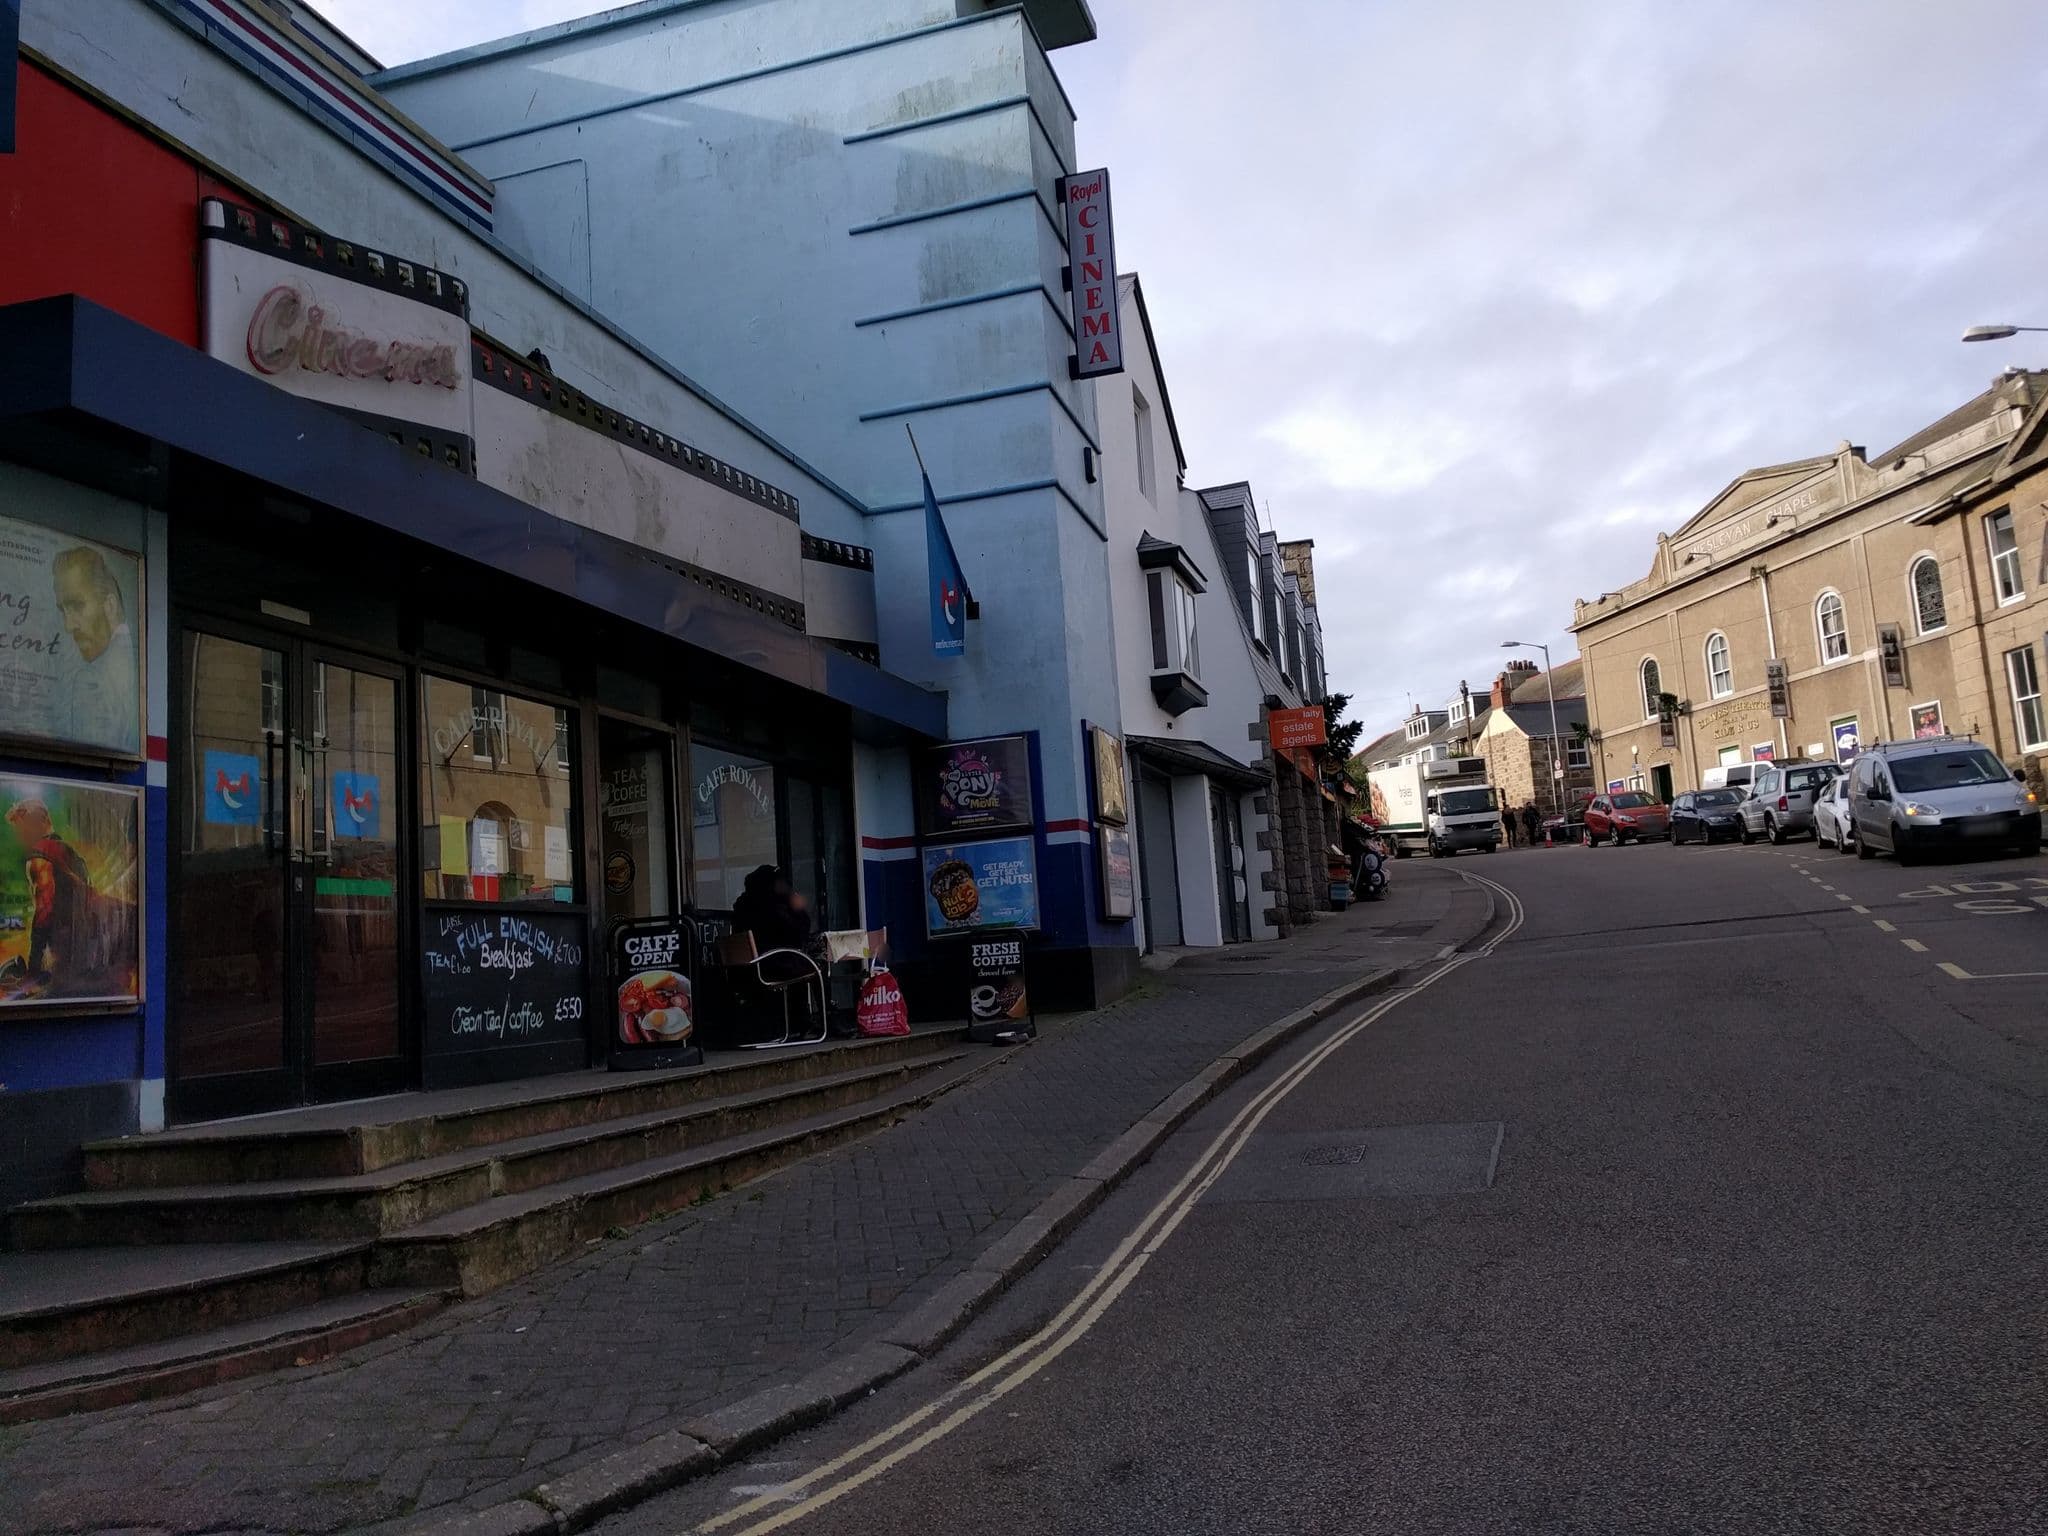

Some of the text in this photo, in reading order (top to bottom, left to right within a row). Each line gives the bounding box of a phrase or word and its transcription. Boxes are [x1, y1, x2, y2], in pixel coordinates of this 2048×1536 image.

[1071, 175, 1102, 203] Royal
[1078, 205, 1112, 364] CINEMA
[246, 285, 457, 390] Cinema
[1766, 490, 1818, 525] CHAPEL
[1282, 722, 1314, 733] estate
[1282, 733, 1317, 747] agents
[612, 767, 636, 784] TEA
[613, 783, 648, 801] COFFE
[699, 764, 769, 813] CAFE ROYALE
[945, 771, 995, 806] PONY
[970, 797, 1000, 809] MOVIE
[982, 862, 998, 871] GET
[988, 869, 1004, 877] GET
[976, 873, 1033, 888] GET NUTS!
[456, 918, 493, 960] FULL
[500, 916, 554, 960] ENGLISH
[625, 930, 680, 954] CAFÉ
[630, 951, 674, 966] OPEN
[971, 941, 1021, 957] FRESH
[426, 951, 451, 974] TEA
[480, 939, 535, 980] Breakfast
[972, 954, 1021, 967] COFFEE
[864, 985, 901, 1006] wilko
